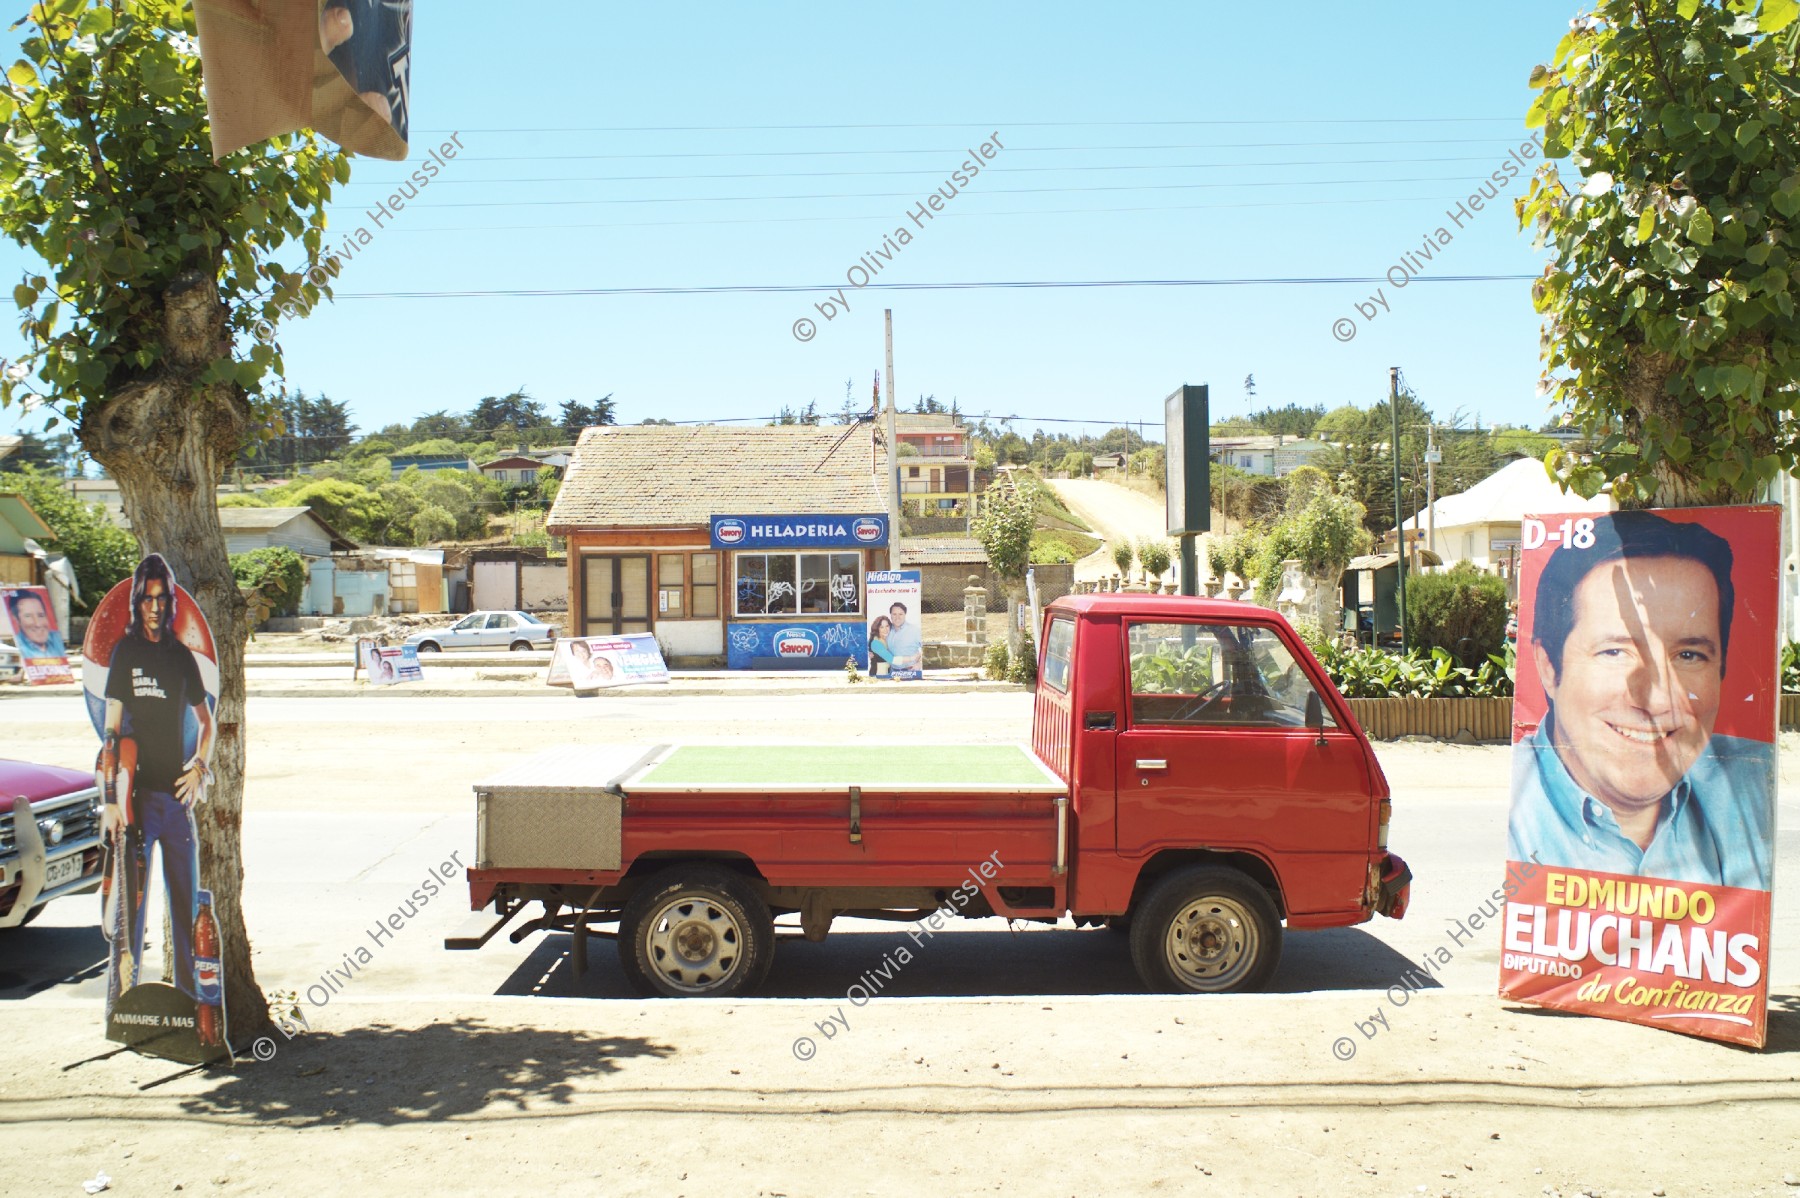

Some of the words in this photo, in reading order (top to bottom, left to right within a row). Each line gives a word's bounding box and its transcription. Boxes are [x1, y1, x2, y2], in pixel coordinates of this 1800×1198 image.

[720, 528, 742, 538] Savory
[751, 524, 848, 537] HELADERIA
[857, 527, 879, 536] Savory
[1523, 517, 1596, 550] D-18
[867, 571, 902, 583] Hidalgo
[780, 641, 813, 656] Savory
[131, 667, 144, 677] SE
[132, 676, 158, 687] HABLA
[1546, 872, 1716, 925] EDMUNDO
[1505, 901, 1761, 988] ELUCHANS
[1504, 953, 1582, 980] DIPUTADO
[1577, 973, 1610, 1003] da
[1614, 976, 1755, 1016] Confianza
[112, 1013, 160, 1026] ANIMARSE
[162, 1015, 170, 1026] A
[171, 1016, 195, 1028] MAS
